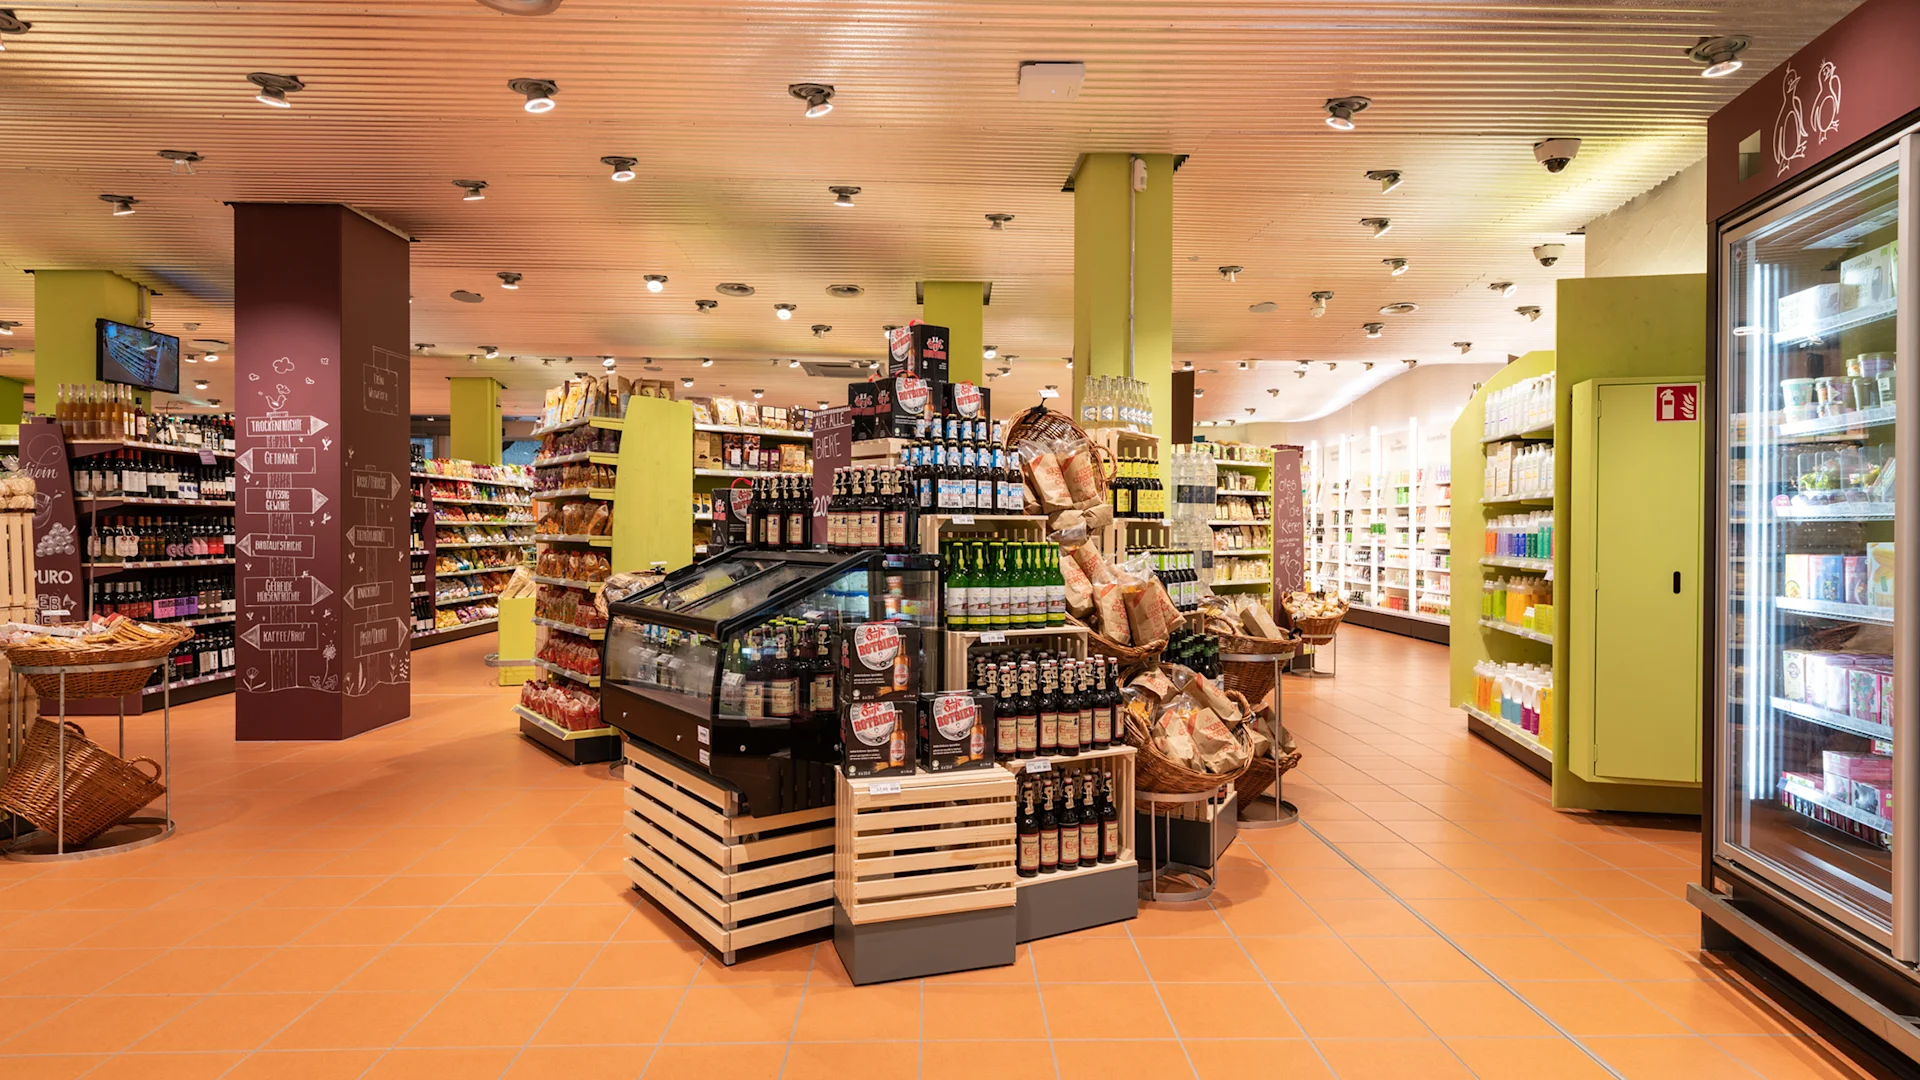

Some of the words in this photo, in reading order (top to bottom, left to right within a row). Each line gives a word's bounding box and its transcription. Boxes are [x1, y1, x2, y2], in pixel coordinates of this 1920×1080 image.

[898, 387, 928, 401] ROTBIER
[815, 415, 827, 430] AUF
[829, 412, 844, 427] ALLE
[815, 433, 842, 460] BIERE
[255, 540, 302, 551] BROTAUFSTRICHE
[858, 635, 899, 657] ROTBIER
[853, 711, 895, 733] ROTBIER
[936, 706, 975, 727] ROTBIER
